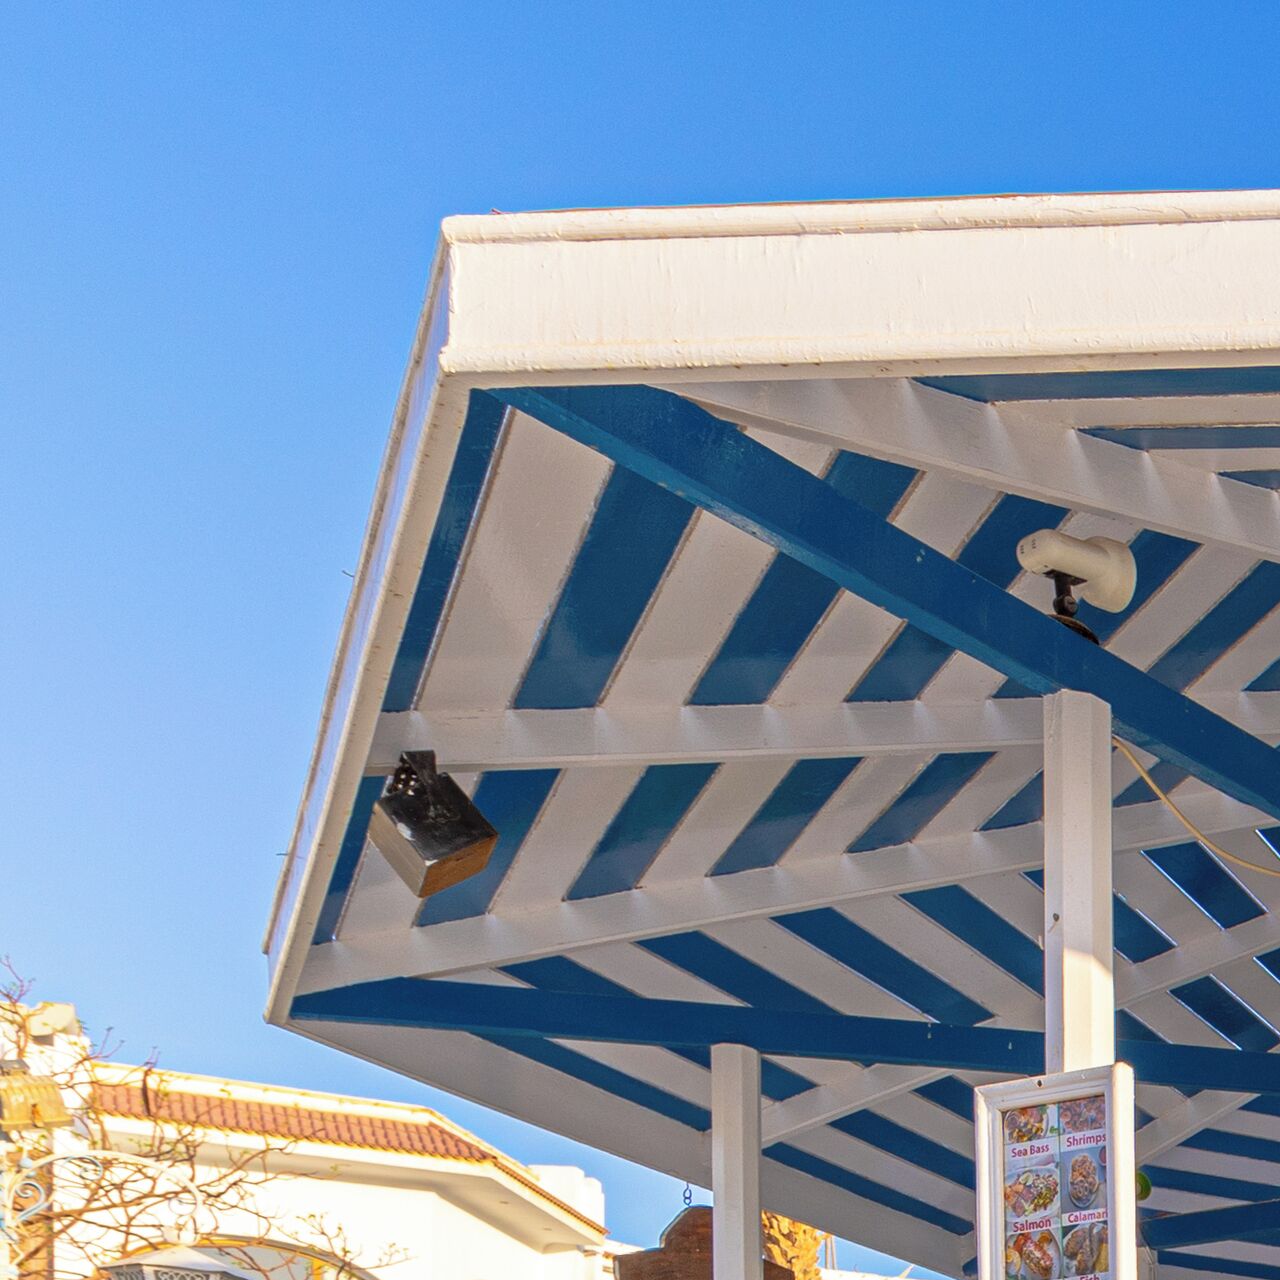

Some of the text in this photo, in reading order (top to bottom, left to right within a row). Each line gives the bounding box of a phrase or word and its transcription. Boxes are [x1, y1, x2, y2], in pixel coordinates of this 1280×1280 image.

[1066, 1132, 1106, 1148] Shrimps
[1011, 1144, 1050, 1158] Sea Bass
[1013, 1217, 1052, 1233] Salmon
